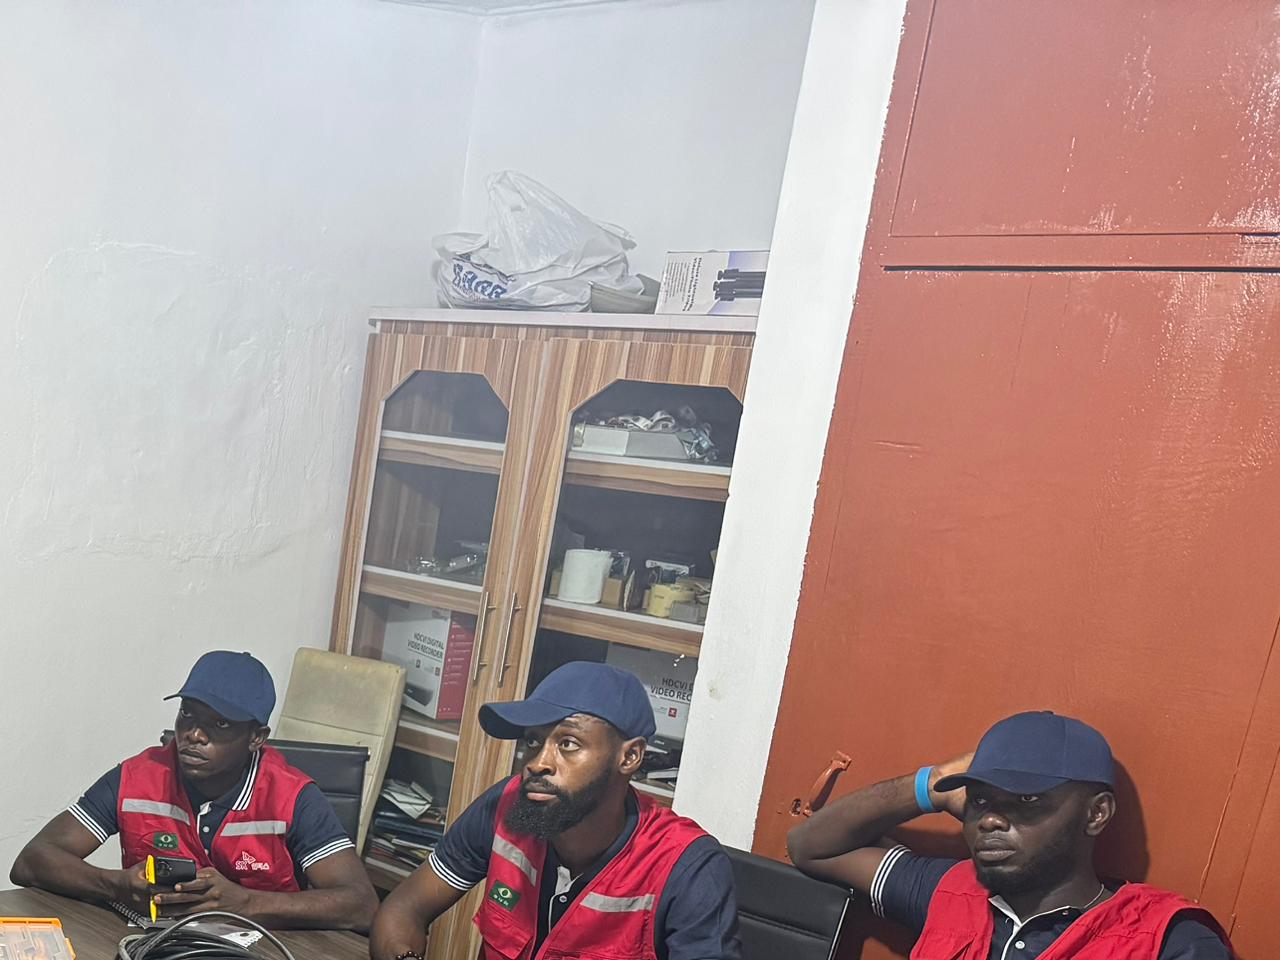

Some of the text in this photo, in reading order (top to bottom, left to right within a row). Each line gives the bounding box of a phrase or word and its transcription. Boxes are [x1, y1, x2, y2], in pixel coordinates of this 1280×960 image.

[407, 640, 443, 659] VIDEO RECORDER
[428, 637, 444, 650] DIGITAL
[662, 678, 688, 690] HDCVI
[651, 686, 675, 698] VIDEO
